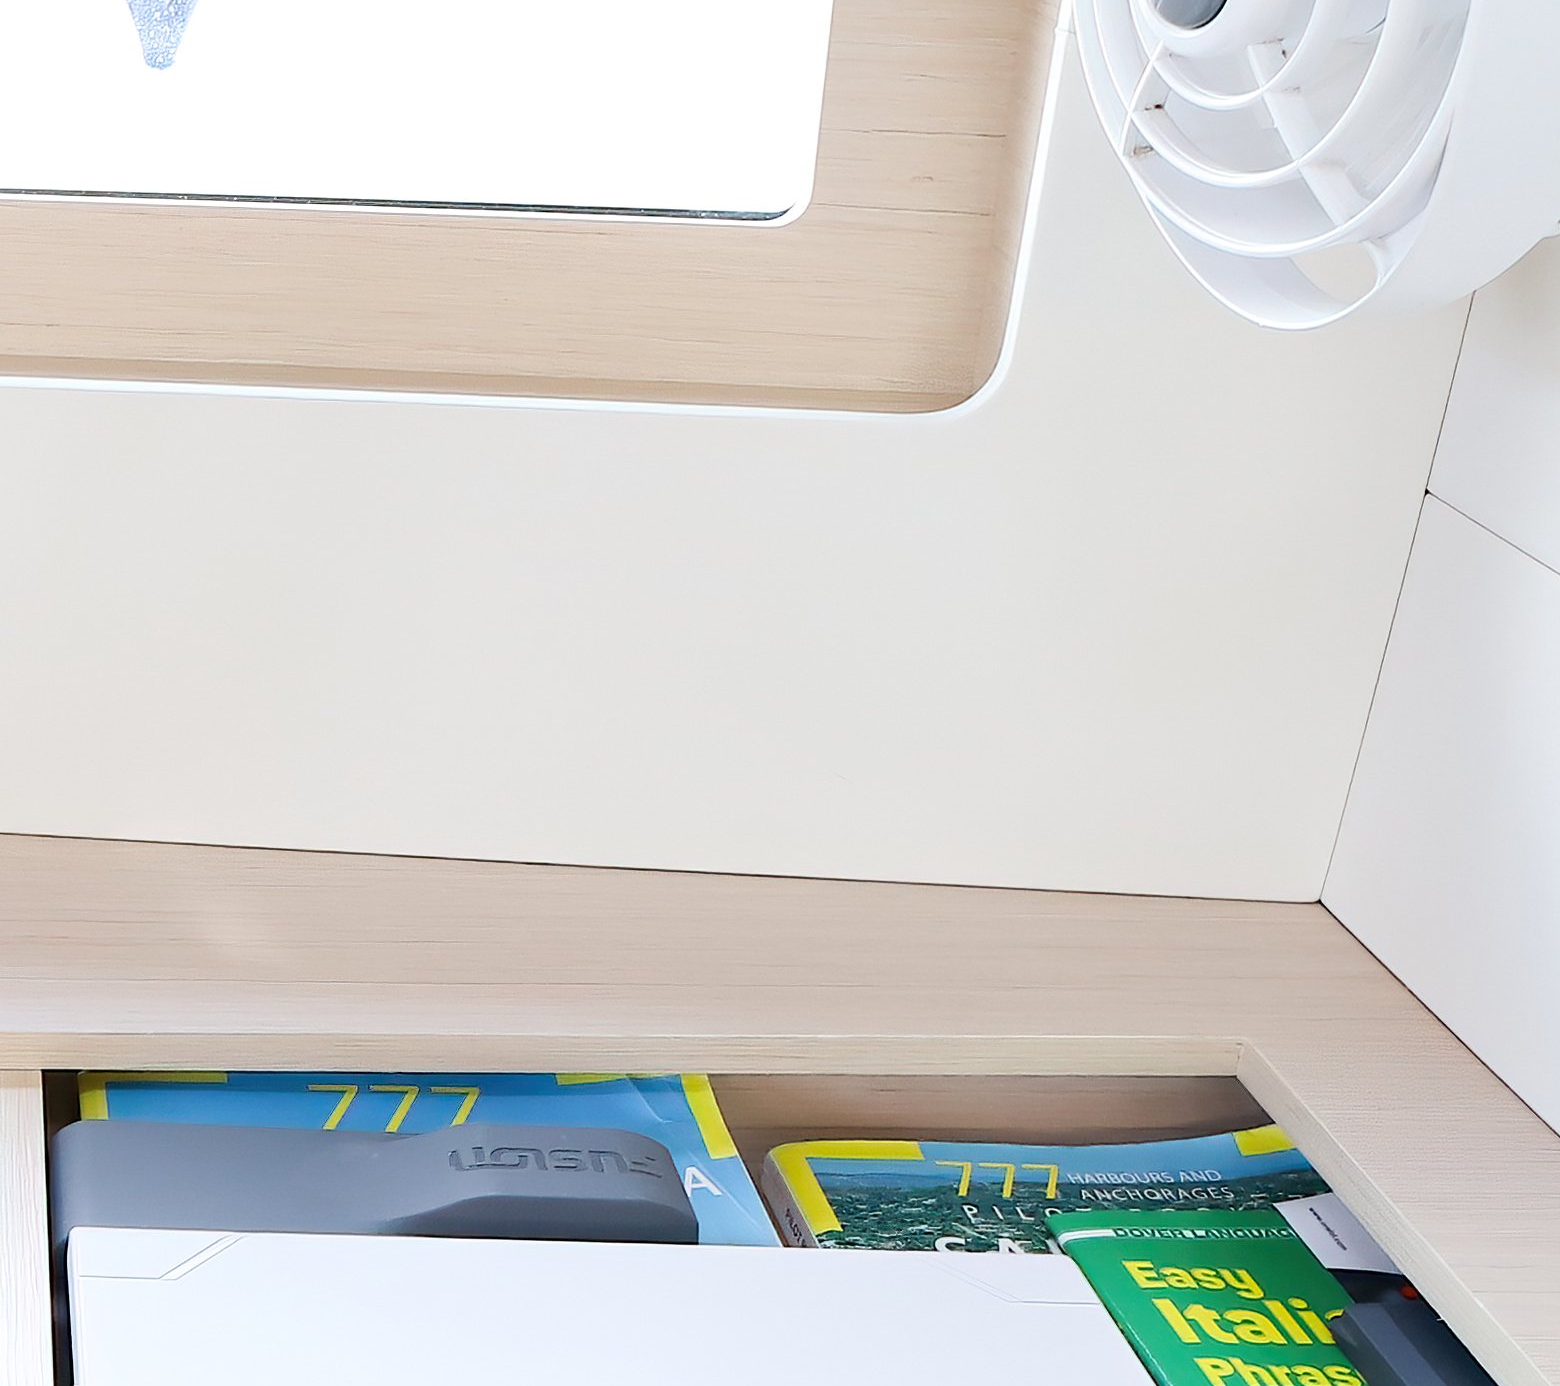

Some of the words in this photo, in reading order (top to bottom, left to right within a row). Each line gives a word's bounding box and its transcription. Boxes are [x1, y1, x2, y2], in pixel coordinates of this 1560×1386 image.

[307, 1085, 480, 1133] 777
[934, 1160, 1058, 1200] 777
[1067, 1170, 1174, 1185] HARBOURS
[1178, 1169, 1222, 1183] AND
[1080, 1184, 1235, 1202] ANCHORAGES
[1188, 1228, 1295, 1240] LANGUAG
[1121, 1259, 1266, 1300] Easy
[1151, 1298, 1346, 1345] Itali
